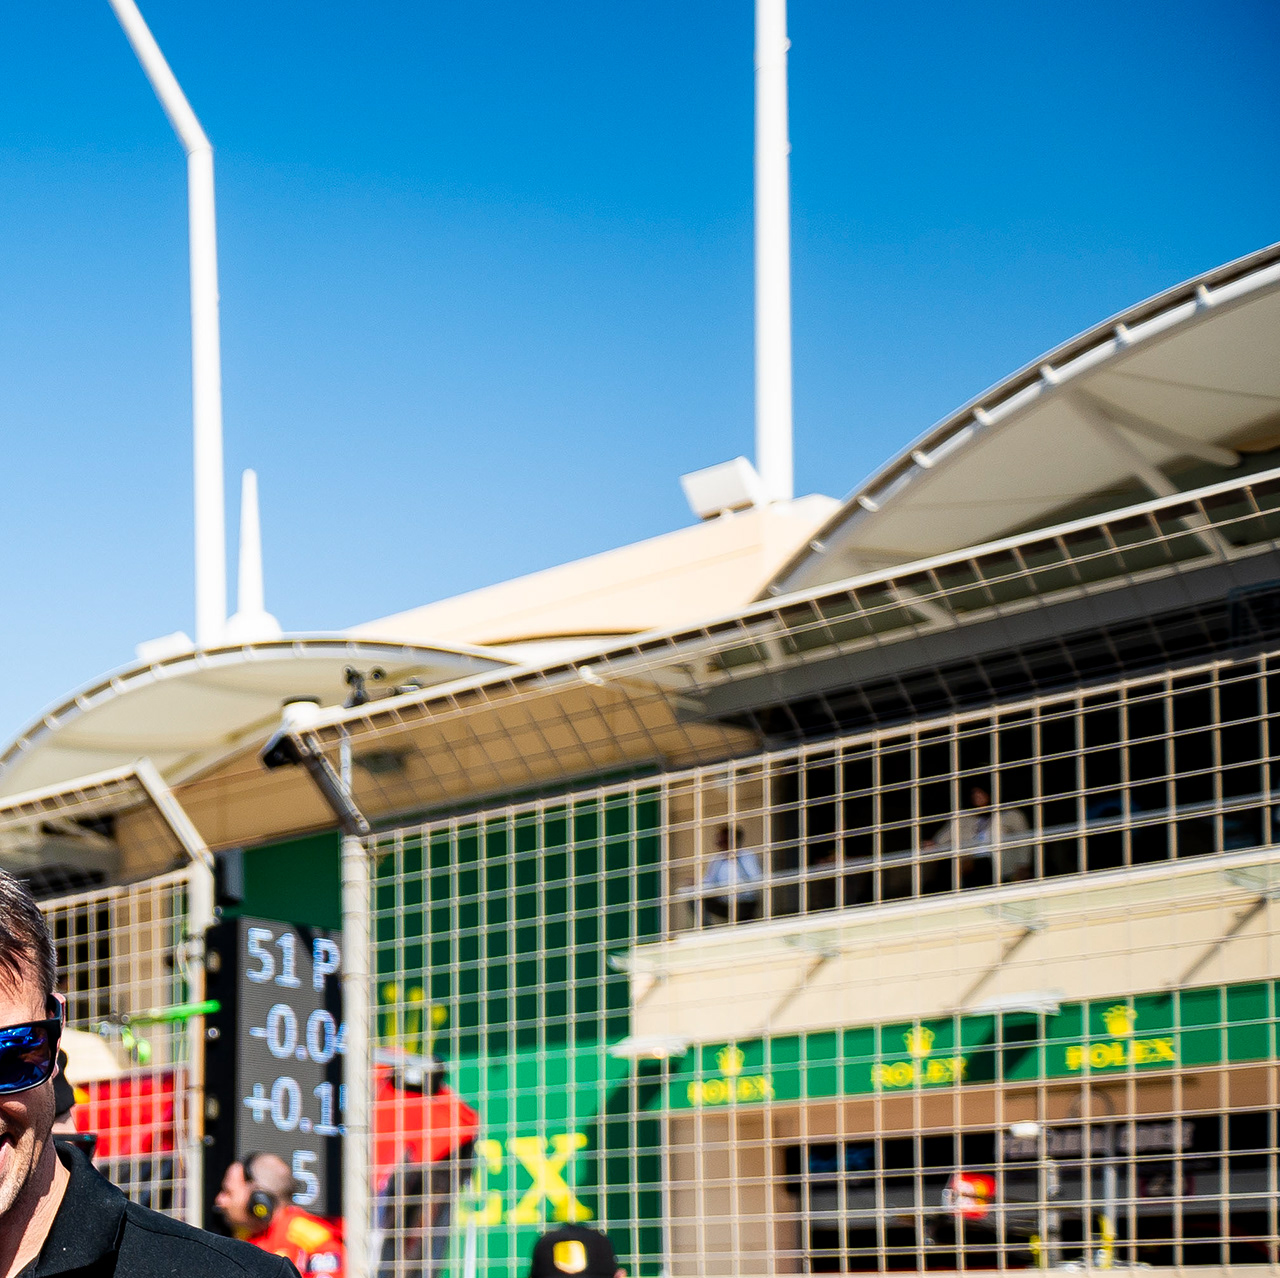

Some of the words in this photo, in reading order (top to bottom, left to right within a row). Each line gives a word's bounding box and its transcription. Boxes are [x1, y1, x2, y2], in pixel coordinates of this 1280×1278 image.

[246, 928, 301, 988] 51
[1066, 1037, 1175, 1071] ROLEX
[871, 1056, 967, 1088] ROLEX
